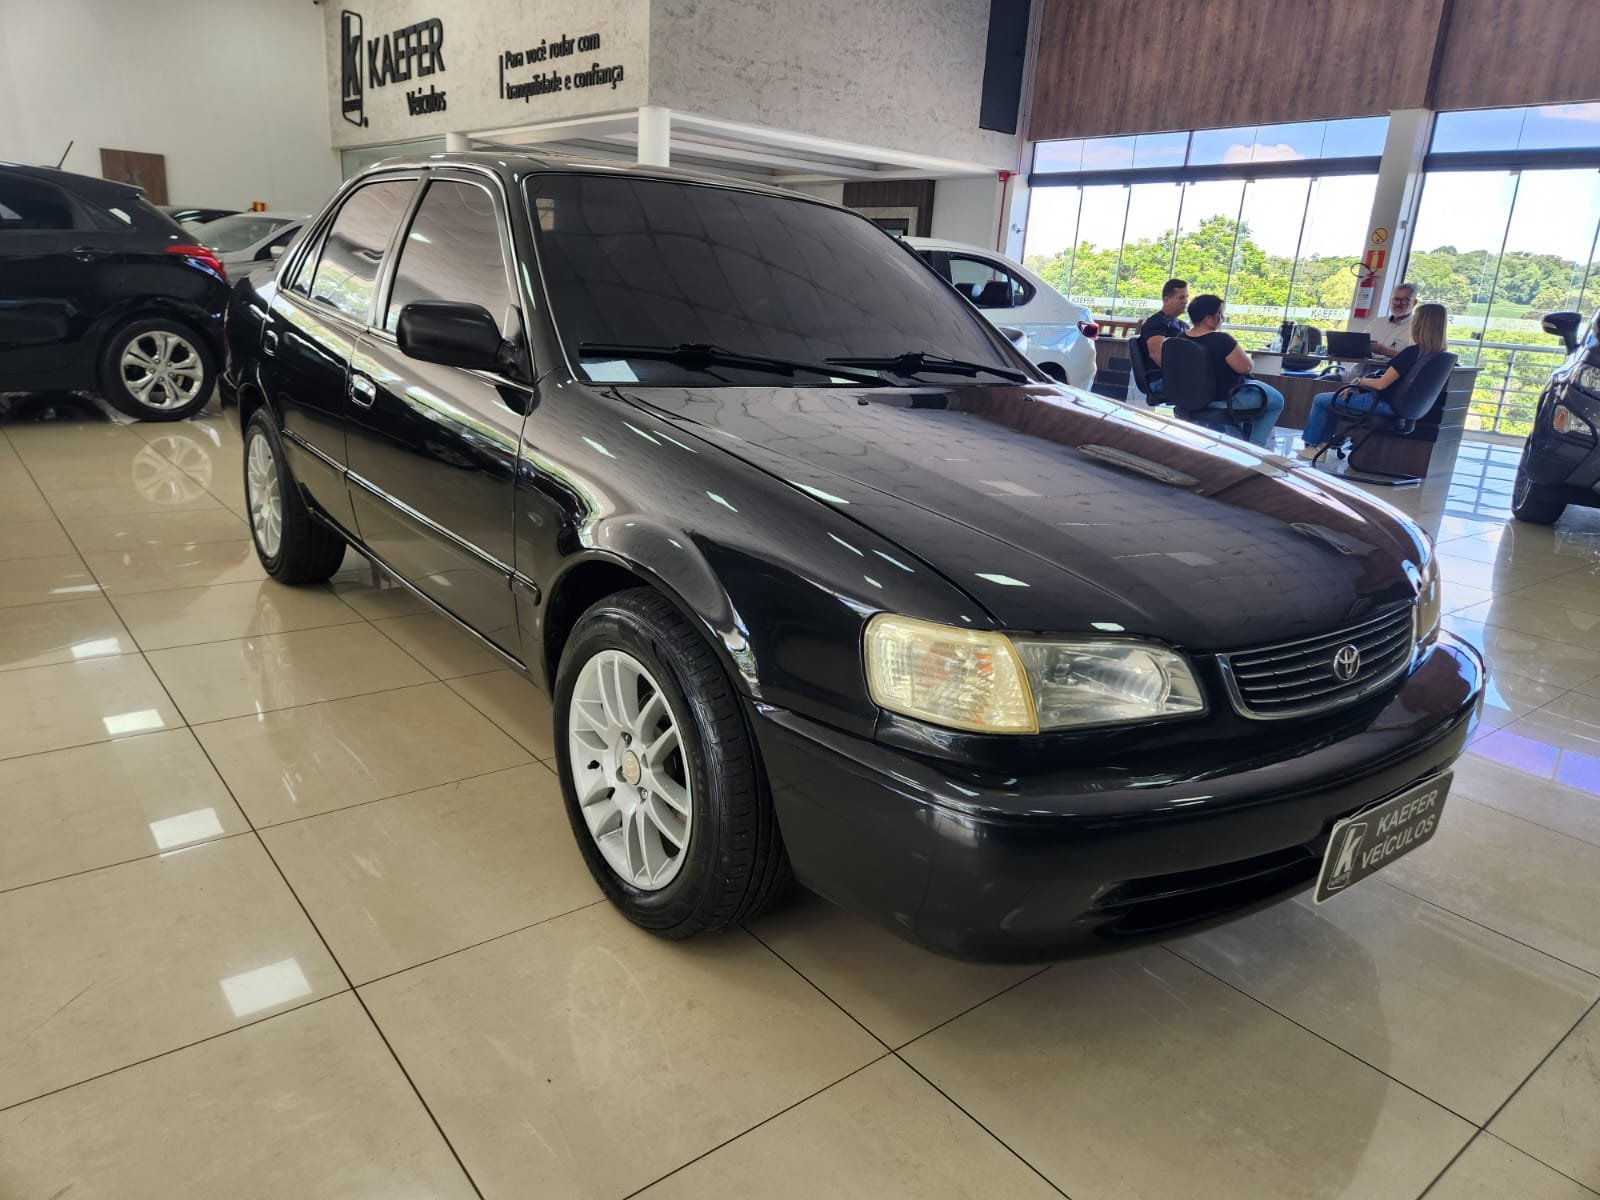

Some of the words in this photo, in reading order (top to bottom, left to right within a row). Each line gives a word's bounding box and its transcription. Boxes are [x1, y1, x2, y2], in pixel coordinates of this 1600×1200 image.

[367, 17, 446, 89] KAEFER
[505, 50, 524, 70] Para
[525, 38, 547, 65] você
[549, 34, 575, 59] rodar
[578, 33, 600, 52] com
[406, 84, 446, 116] Veículos
[506, 70, 562, 103] tranquilidade
[564, 74, 571, 90] e
[574, 62, 624, 90] confiança
[1376, 789, 1438, 837] KAEFER
[1362, 814, 1435, 869] VEÍCULOS
